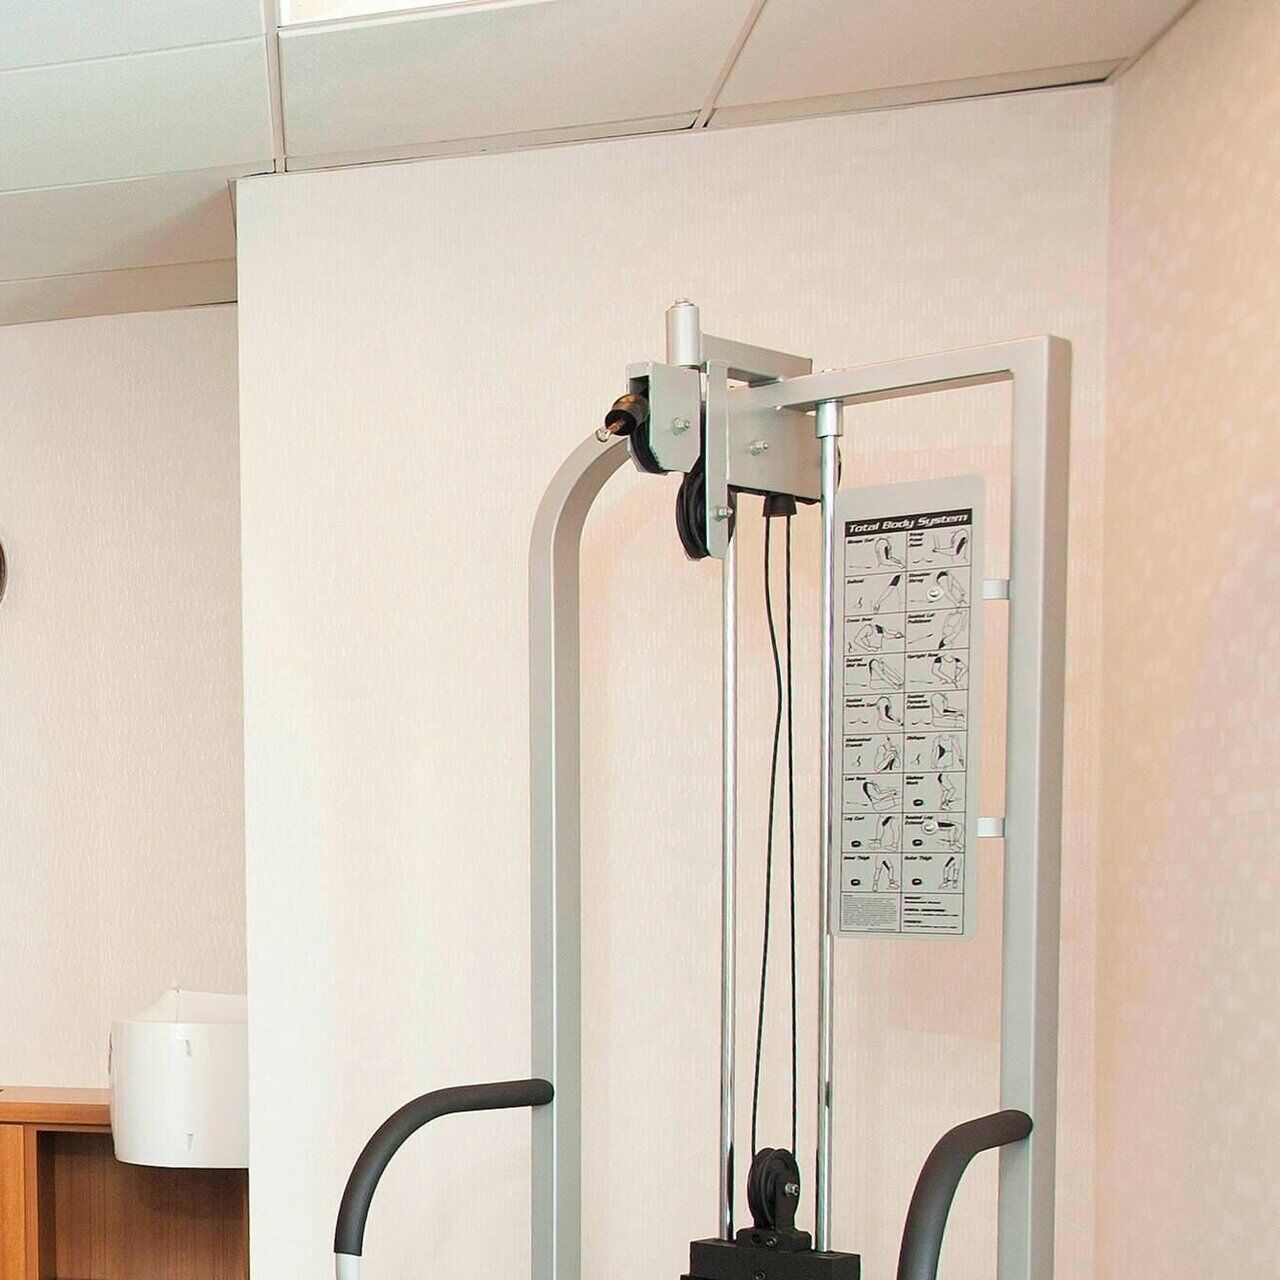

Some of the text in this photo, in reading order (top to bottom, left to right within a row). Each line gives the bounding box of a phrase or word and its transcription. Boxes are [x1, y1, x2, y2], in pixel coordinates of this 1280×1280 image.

[849, 514, 968, 534] Total Body System
